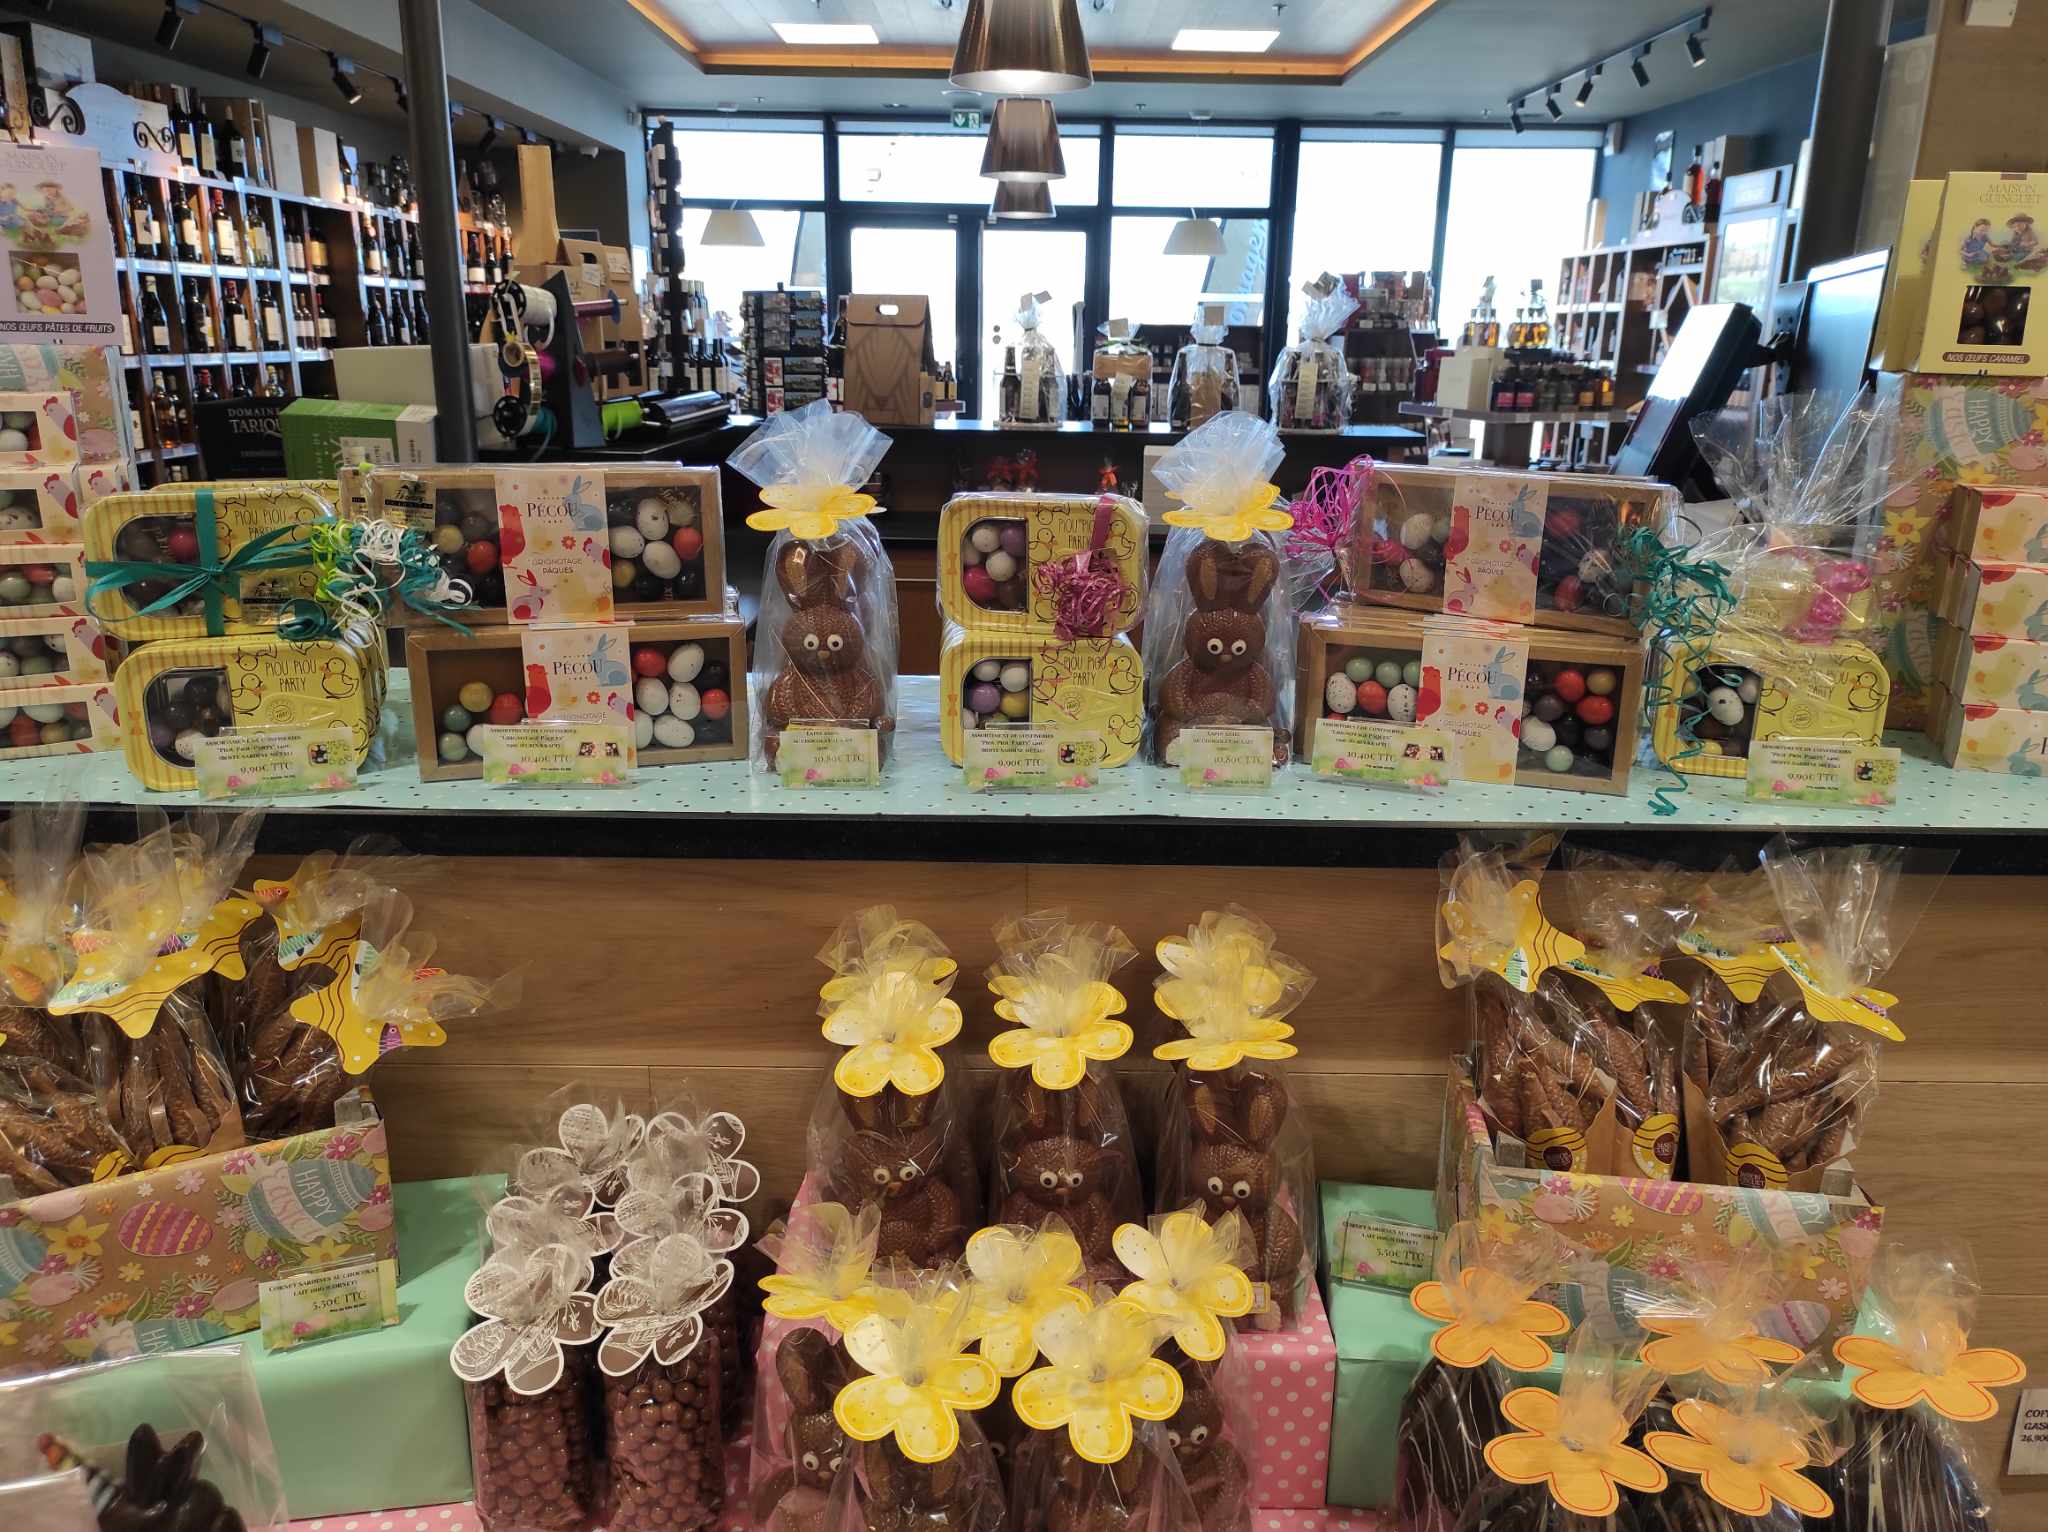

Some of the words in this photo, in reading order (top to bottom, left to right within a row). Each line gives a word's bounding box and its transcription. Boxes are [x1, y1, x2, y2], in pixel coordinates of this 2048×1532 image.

[72, 324, 83, 333] DE
[84, 324, 113, 333] FRUITS
[1989, 354, 2025, 363] CARAMEL
[1968, 399, 1993, 444] HAPPY
[265, 662, 289, 677] PIOU
[294, 660, 317, 674] PIOU
[279, 677, 306, 692] PARTY
[1072, 672, 1096, 687] PARTY
[295, 1168, 337, 1219] HAPPY
[1404, 1248, 1425, 1262] TTC
[343, 1291, 367, 1304] TTC
[2025, 1409, 2048, 1418] COF
[2024, 1422, 2048, 1431] GAS
